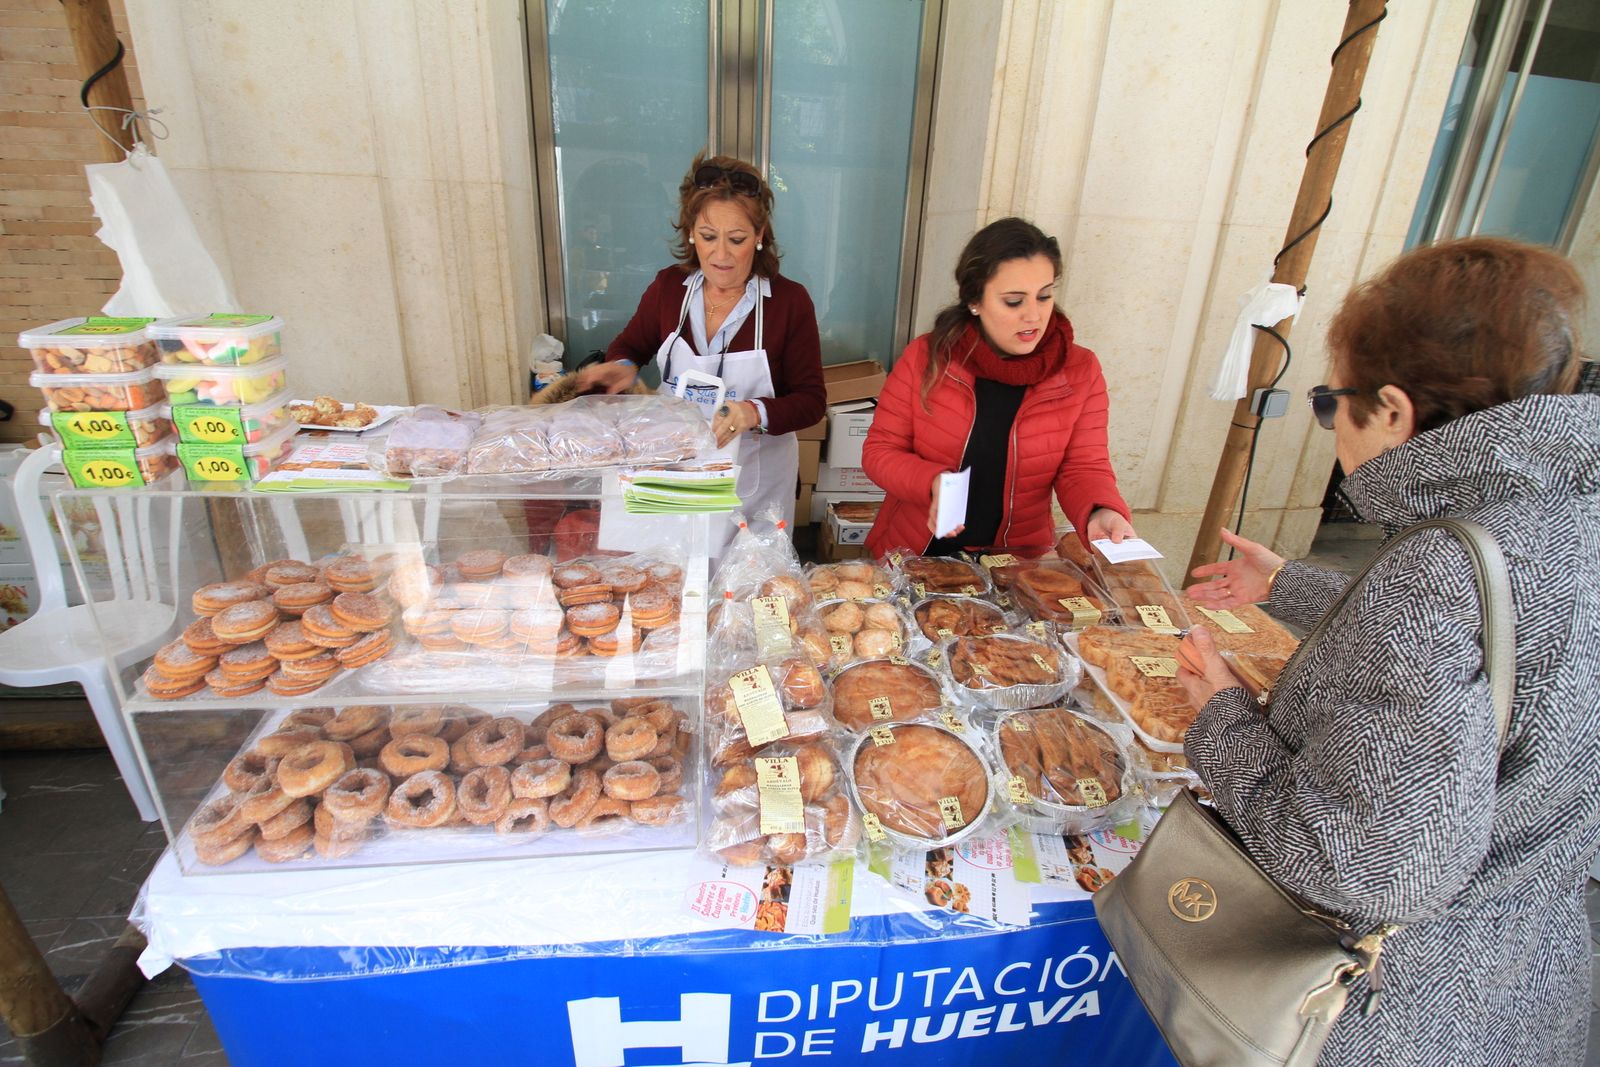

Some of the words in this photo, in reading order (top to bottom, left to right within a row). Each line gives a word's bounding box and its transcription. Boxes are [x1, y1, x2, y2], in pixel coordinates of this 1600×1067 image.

[193, 422, 226, 435] 1,00
[231, 428, 239, 437] €
[198, 461, 230, 474] 1,00
[235, 467, 243, 476] €
[736, 668, 759, 679] VILLA
[754, 1028, 836, 1059] DE
[860, 990, 1101, 1053] HUELVA
